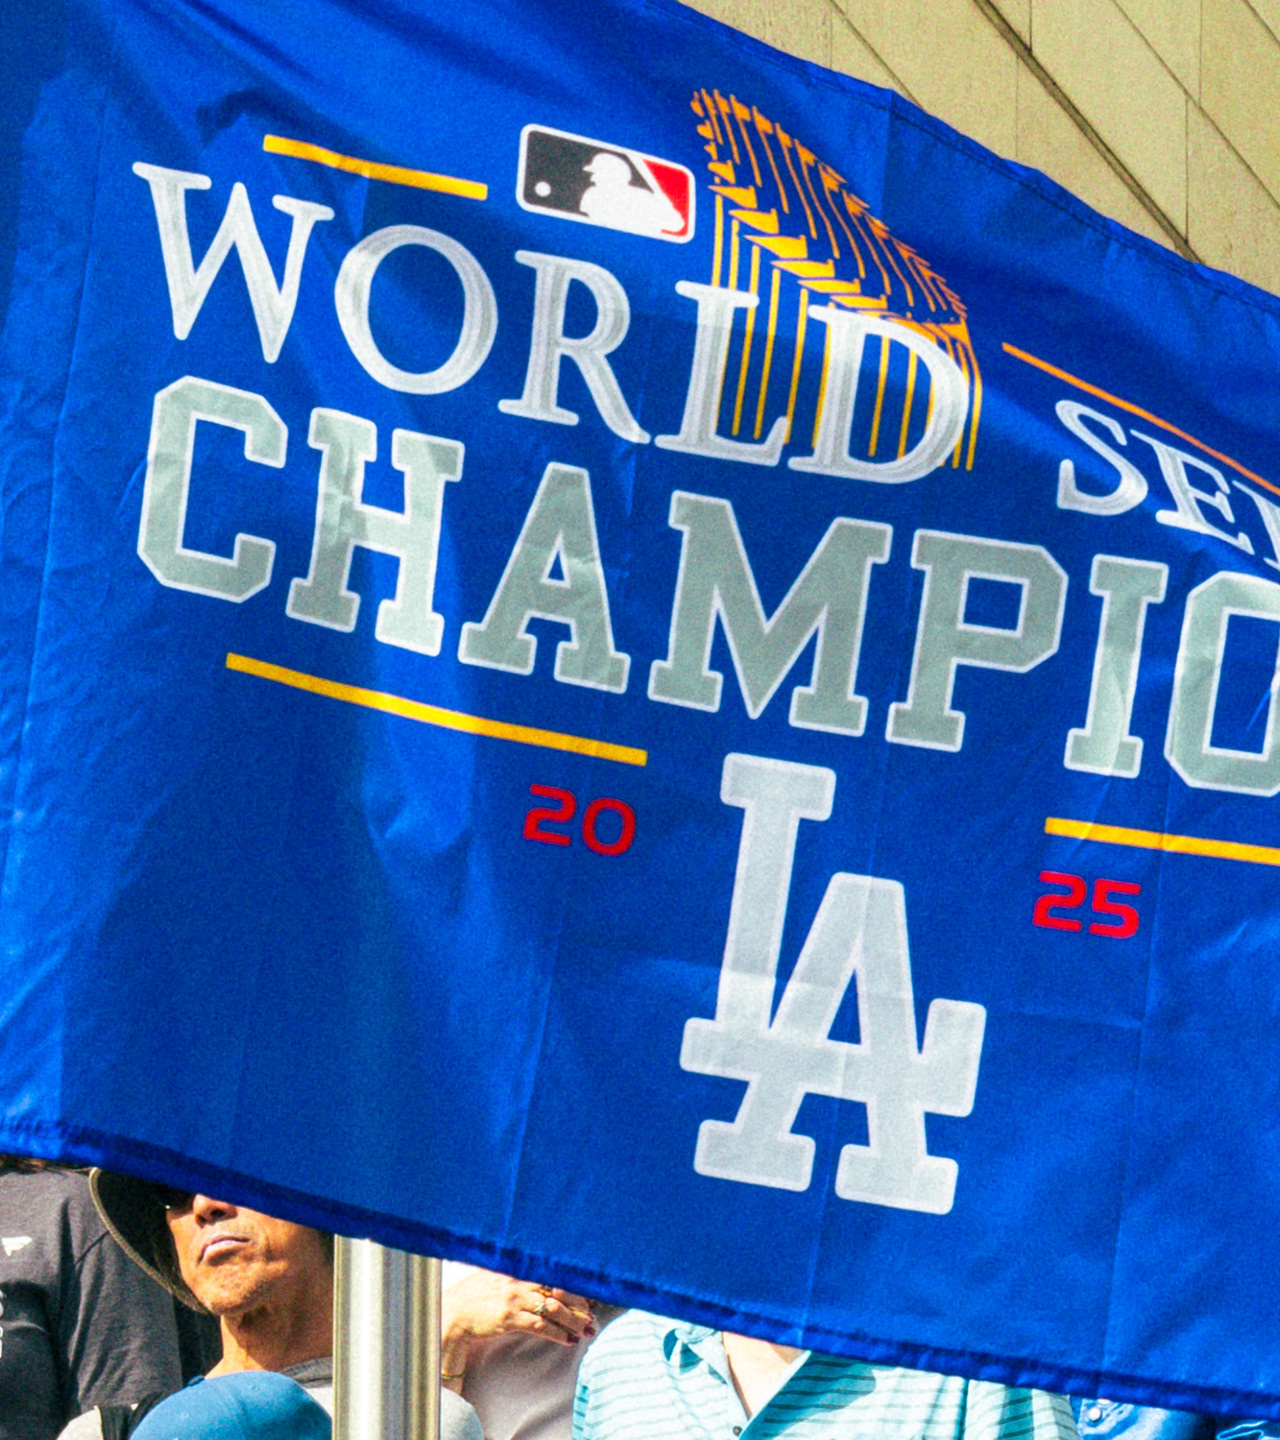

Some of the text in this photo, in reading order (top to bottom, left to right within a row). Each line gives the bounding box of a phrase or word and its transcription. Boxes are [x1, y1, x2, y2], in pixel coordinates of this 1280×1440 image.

[134, 160, 978, 485] WORLD
[523, 784, 1143, 942] 20 25
[680, 752, 988, 1215] LA
